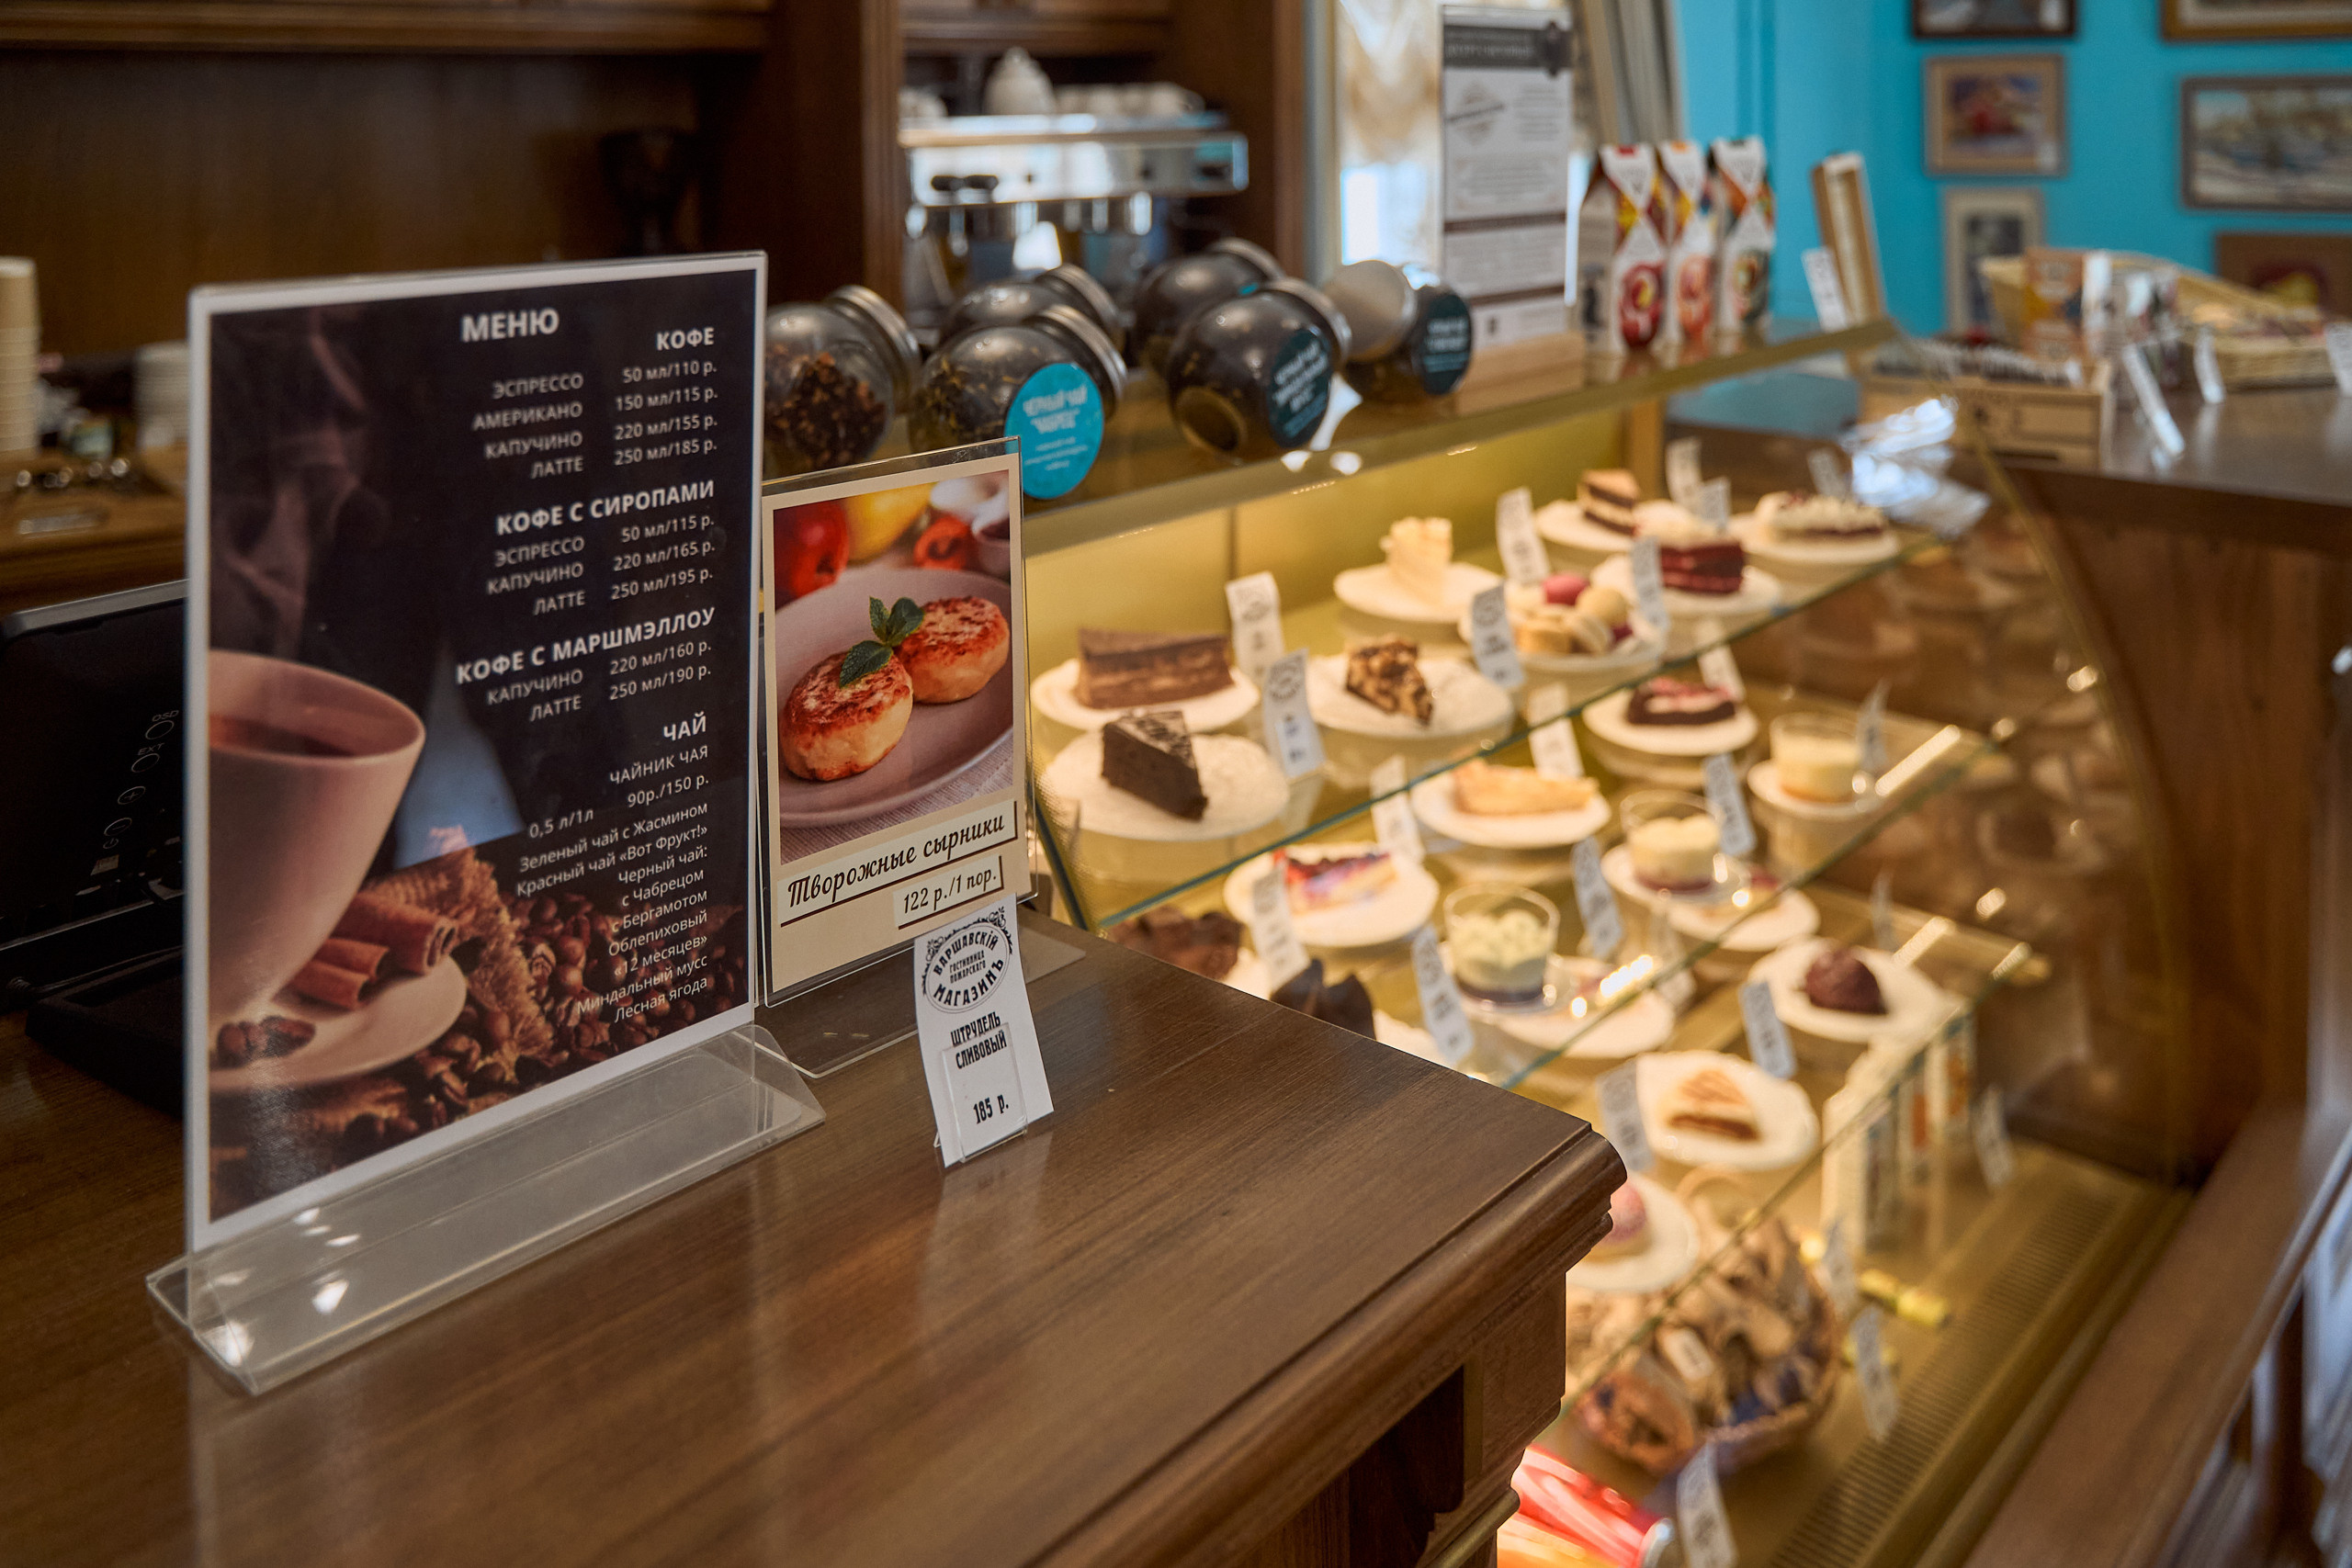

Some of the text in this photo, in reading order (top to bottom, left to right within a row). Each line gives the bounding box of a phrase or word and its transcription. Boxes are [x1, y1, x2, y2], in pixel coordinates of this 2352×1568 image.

[461, 308, 560, 343] МЕНЮ
[656, 326, 715, 351] КОФЕ
[492, 360, 718, 399] ЭСПРЕССО 50 мл/110 р.
[471, 387, 718, 431] АМЕРИКАНО 150 мл/115 р.
[484, 416, 718, 459] КАПУЧИНО 220 мл/155 р.
[530, 439, 718, 479] ЛАТТЕ 250 мл/185 р.
[496, 479, 715, 536] КОФЕ С СИРОПАМИ
[495, 515, 715, 568] ЭСПРЕССО 50 мл/115 р.
[487, 540, 715, 595] КАПУЧИНО 220 мл/165 р.
[533, 569, 713, 615] ЛАТТЕ 250 мл/195 р.
[456, 606, 715, 685] КОФЕ С МАРШМЭЛЛОУ
[487, 640, 712, 706] КАПУЧИНО 220 мл/160 р.
[529, 665, 711, 722] ЛАТТЕ 250 мл/190 р.
[152, 710, 179, 722] OSD
[663, 711, 707, 741] ЧАЙ
[138, 742, 165, 755] EXT
[610, 745, 708, 784] ЧАЙНИК ЧАЯ
[529, 774, 709, 839] 0,5 л/1л 90р./150 р.
[520, 803, 708, 873] Зеленый чай с Жасмином
[517, 824, 708, 897] Красный чай «Вот Фрукт!»
[618, 844, 708, 885] Черный чай:
[787, 815, 1005, 908] Творожные сырники
[622, 869, 704, 907] с Чабрецом
[903, 869, 997, 914] 122 р./1 пор.
[609, 909, 707, 956] Облепиховый
[612, 890, 707, 933] с Бергамотом
[614, 935, 707, 977] «12 месяцев»
[577, 955, 707, 1015] Миндальный мусс
[615, 977, 707, 1023] Лесная ягода
[950, 1011, 1001, 1047] ШТРУДЕЛЬ
[956, 1029, 1007, 1069] СЛИВОВЫЙ
[973, 1094, 1009, 1124] 185 р.
